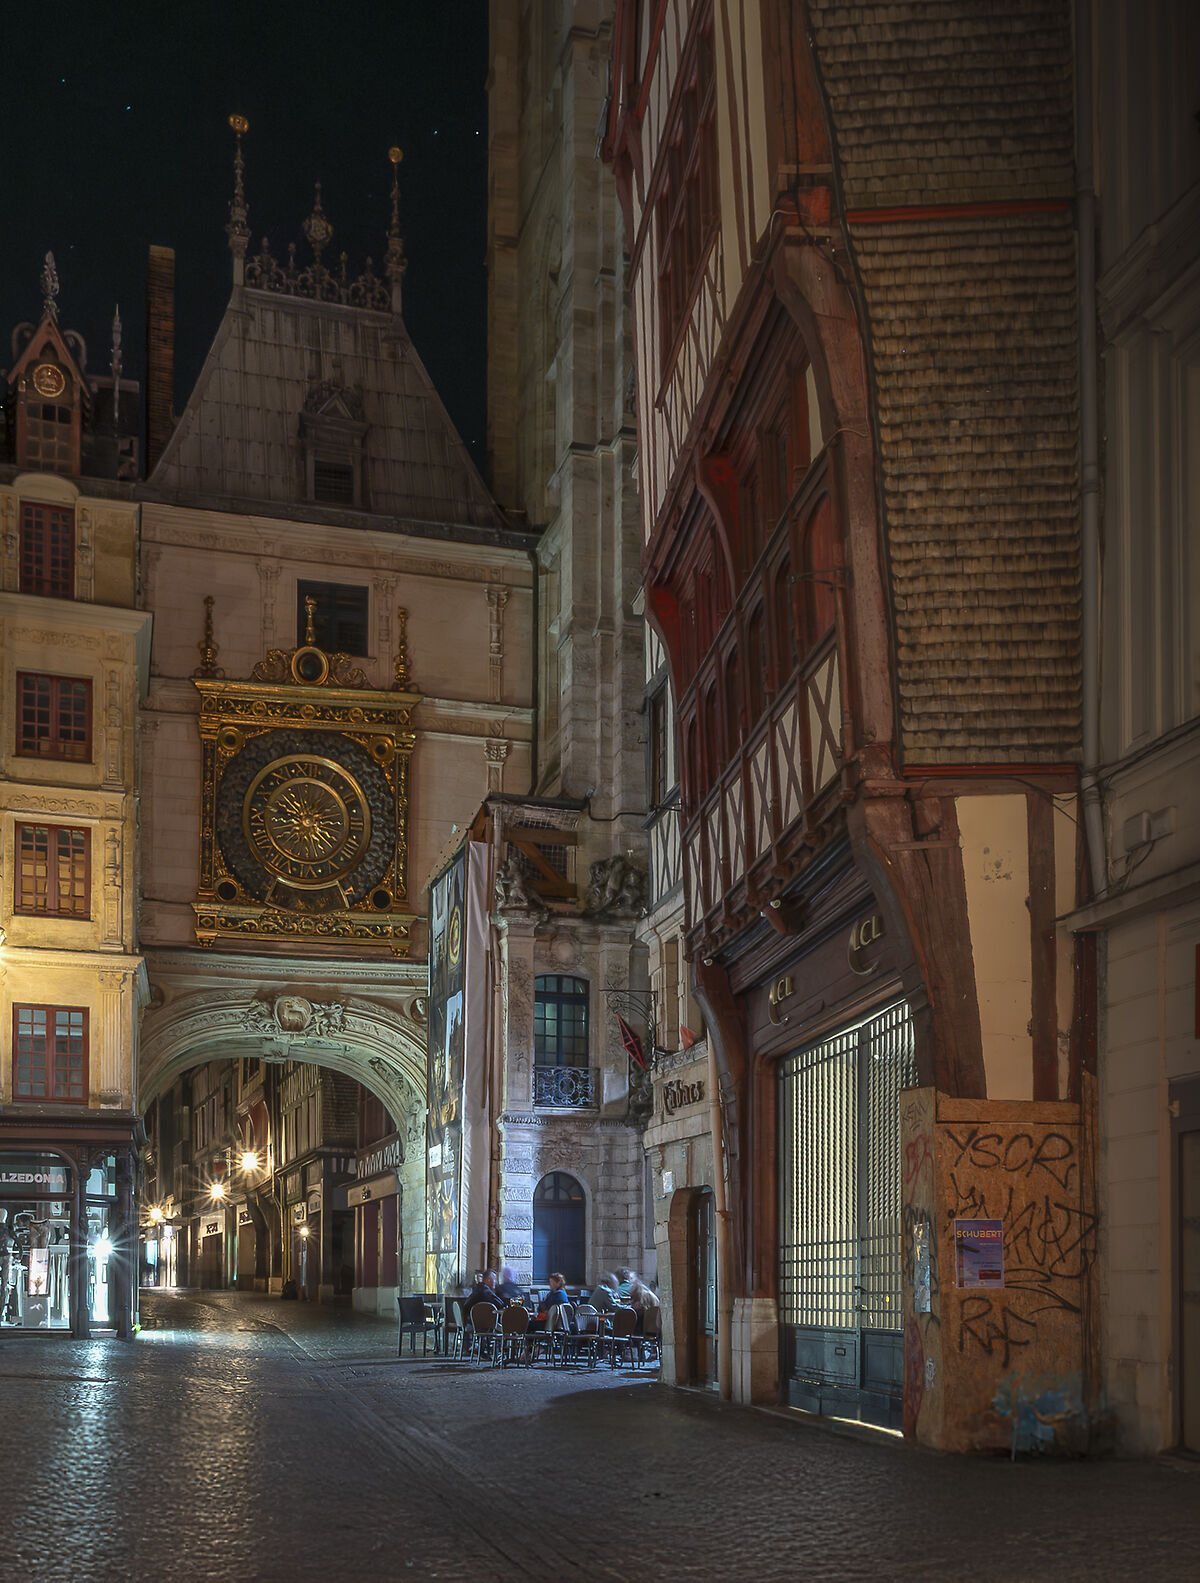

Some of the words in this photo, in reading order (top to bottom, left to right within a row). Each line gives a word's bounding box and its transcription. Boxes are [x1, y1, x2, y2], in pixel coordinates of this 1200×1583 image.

[272, 766, 291, 784] XI
[295, 763, 318, 777] XII
[343, 792, 356, 804] II
[350, 817, 363, 831] III
[341, 838, 360, 859] IIII
[300, 863, 318, 878] VI
[327, 860, 340, 874] V
[850, 915, 882, 951] LCL
[769, 976, 793, 1005] LCL
[956, 1230, 1003, 1239] SCHUBERT
